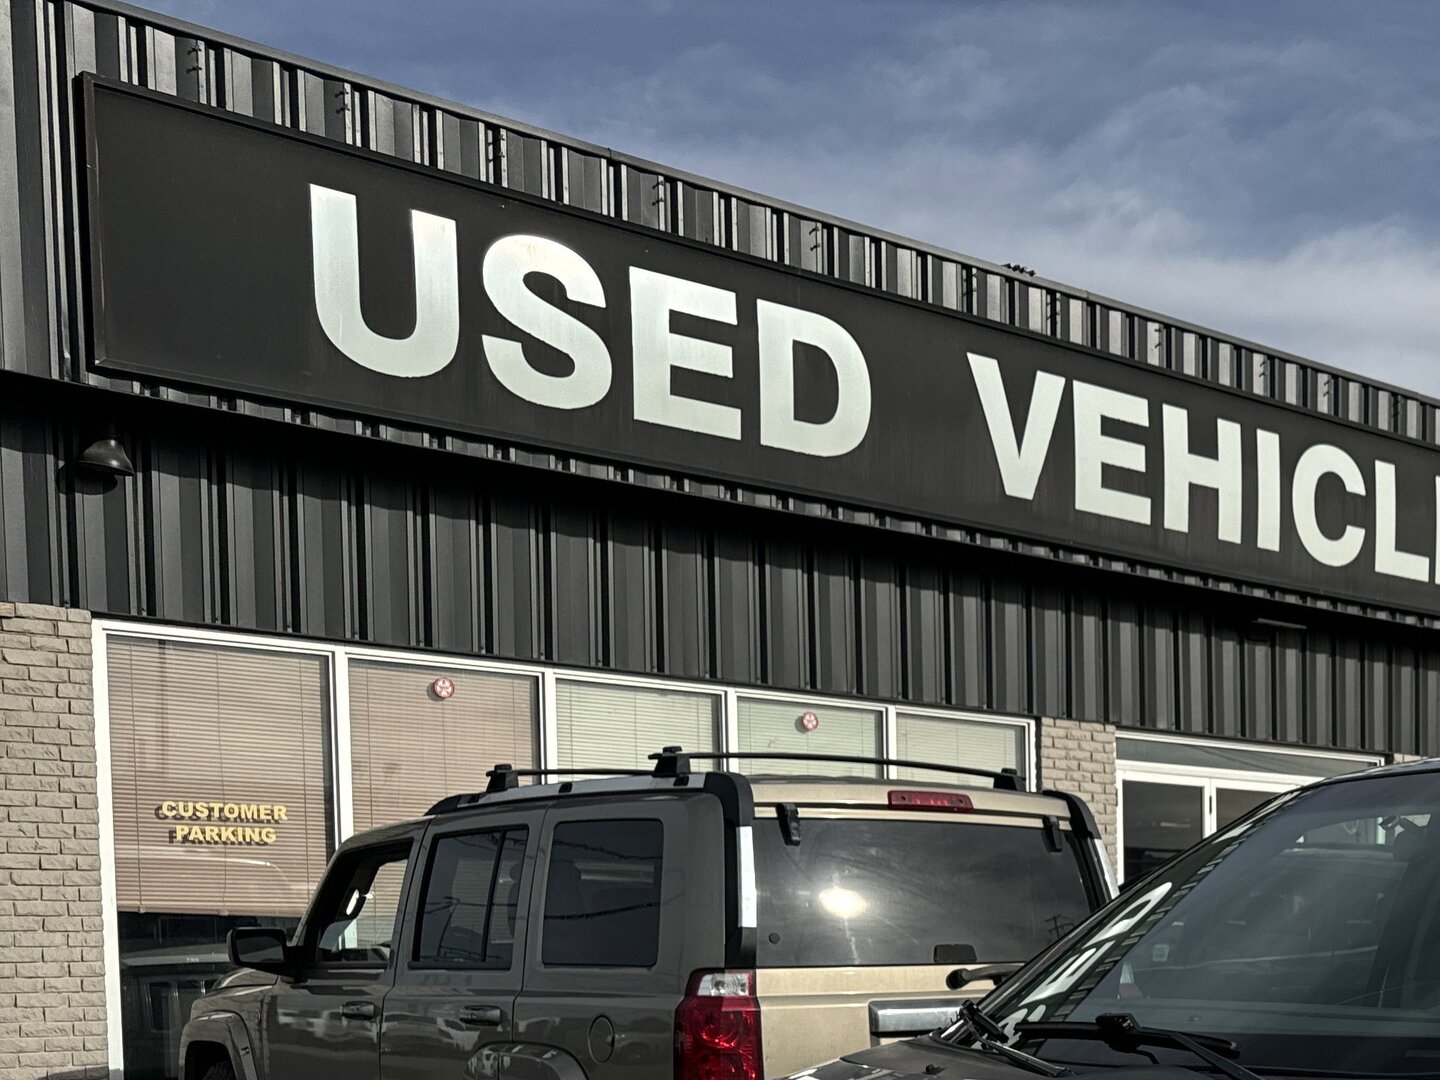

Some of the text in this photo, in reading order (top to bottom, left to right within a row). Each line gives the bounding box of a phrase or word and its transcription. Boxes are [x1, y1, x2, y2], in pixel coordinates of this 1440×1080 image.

[310, 183, 872, 458] USED
[162, 801, 288, 820] CUSTOMER
[175, 825, 277, 843] PARKING
